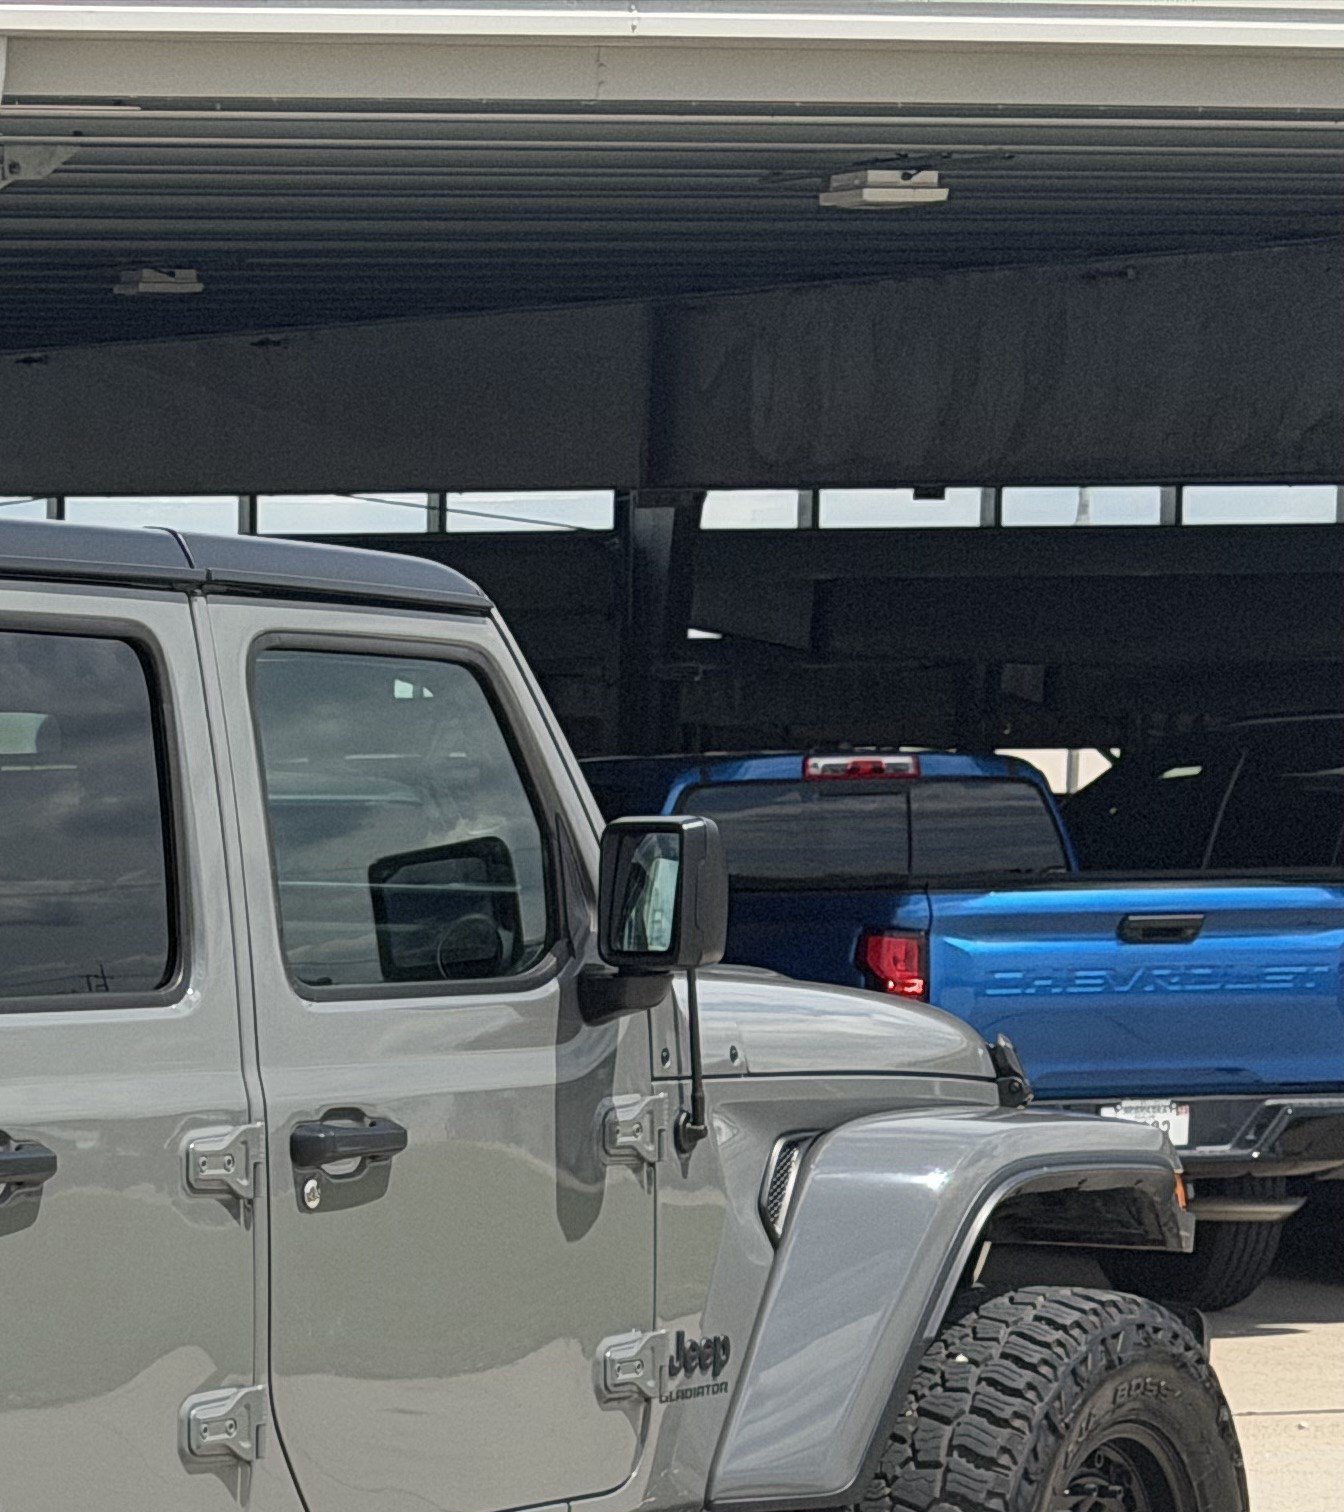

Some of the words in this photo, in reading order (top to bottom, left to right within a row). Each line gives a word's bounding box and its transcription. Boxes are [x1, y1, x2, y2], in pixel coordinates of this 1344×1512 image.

[985, 963, 1330, 996] CHEVROLET
[668, 1330, 731, 1380] Jeep
[659, 1381, 729, 1404] GLADIATOR
